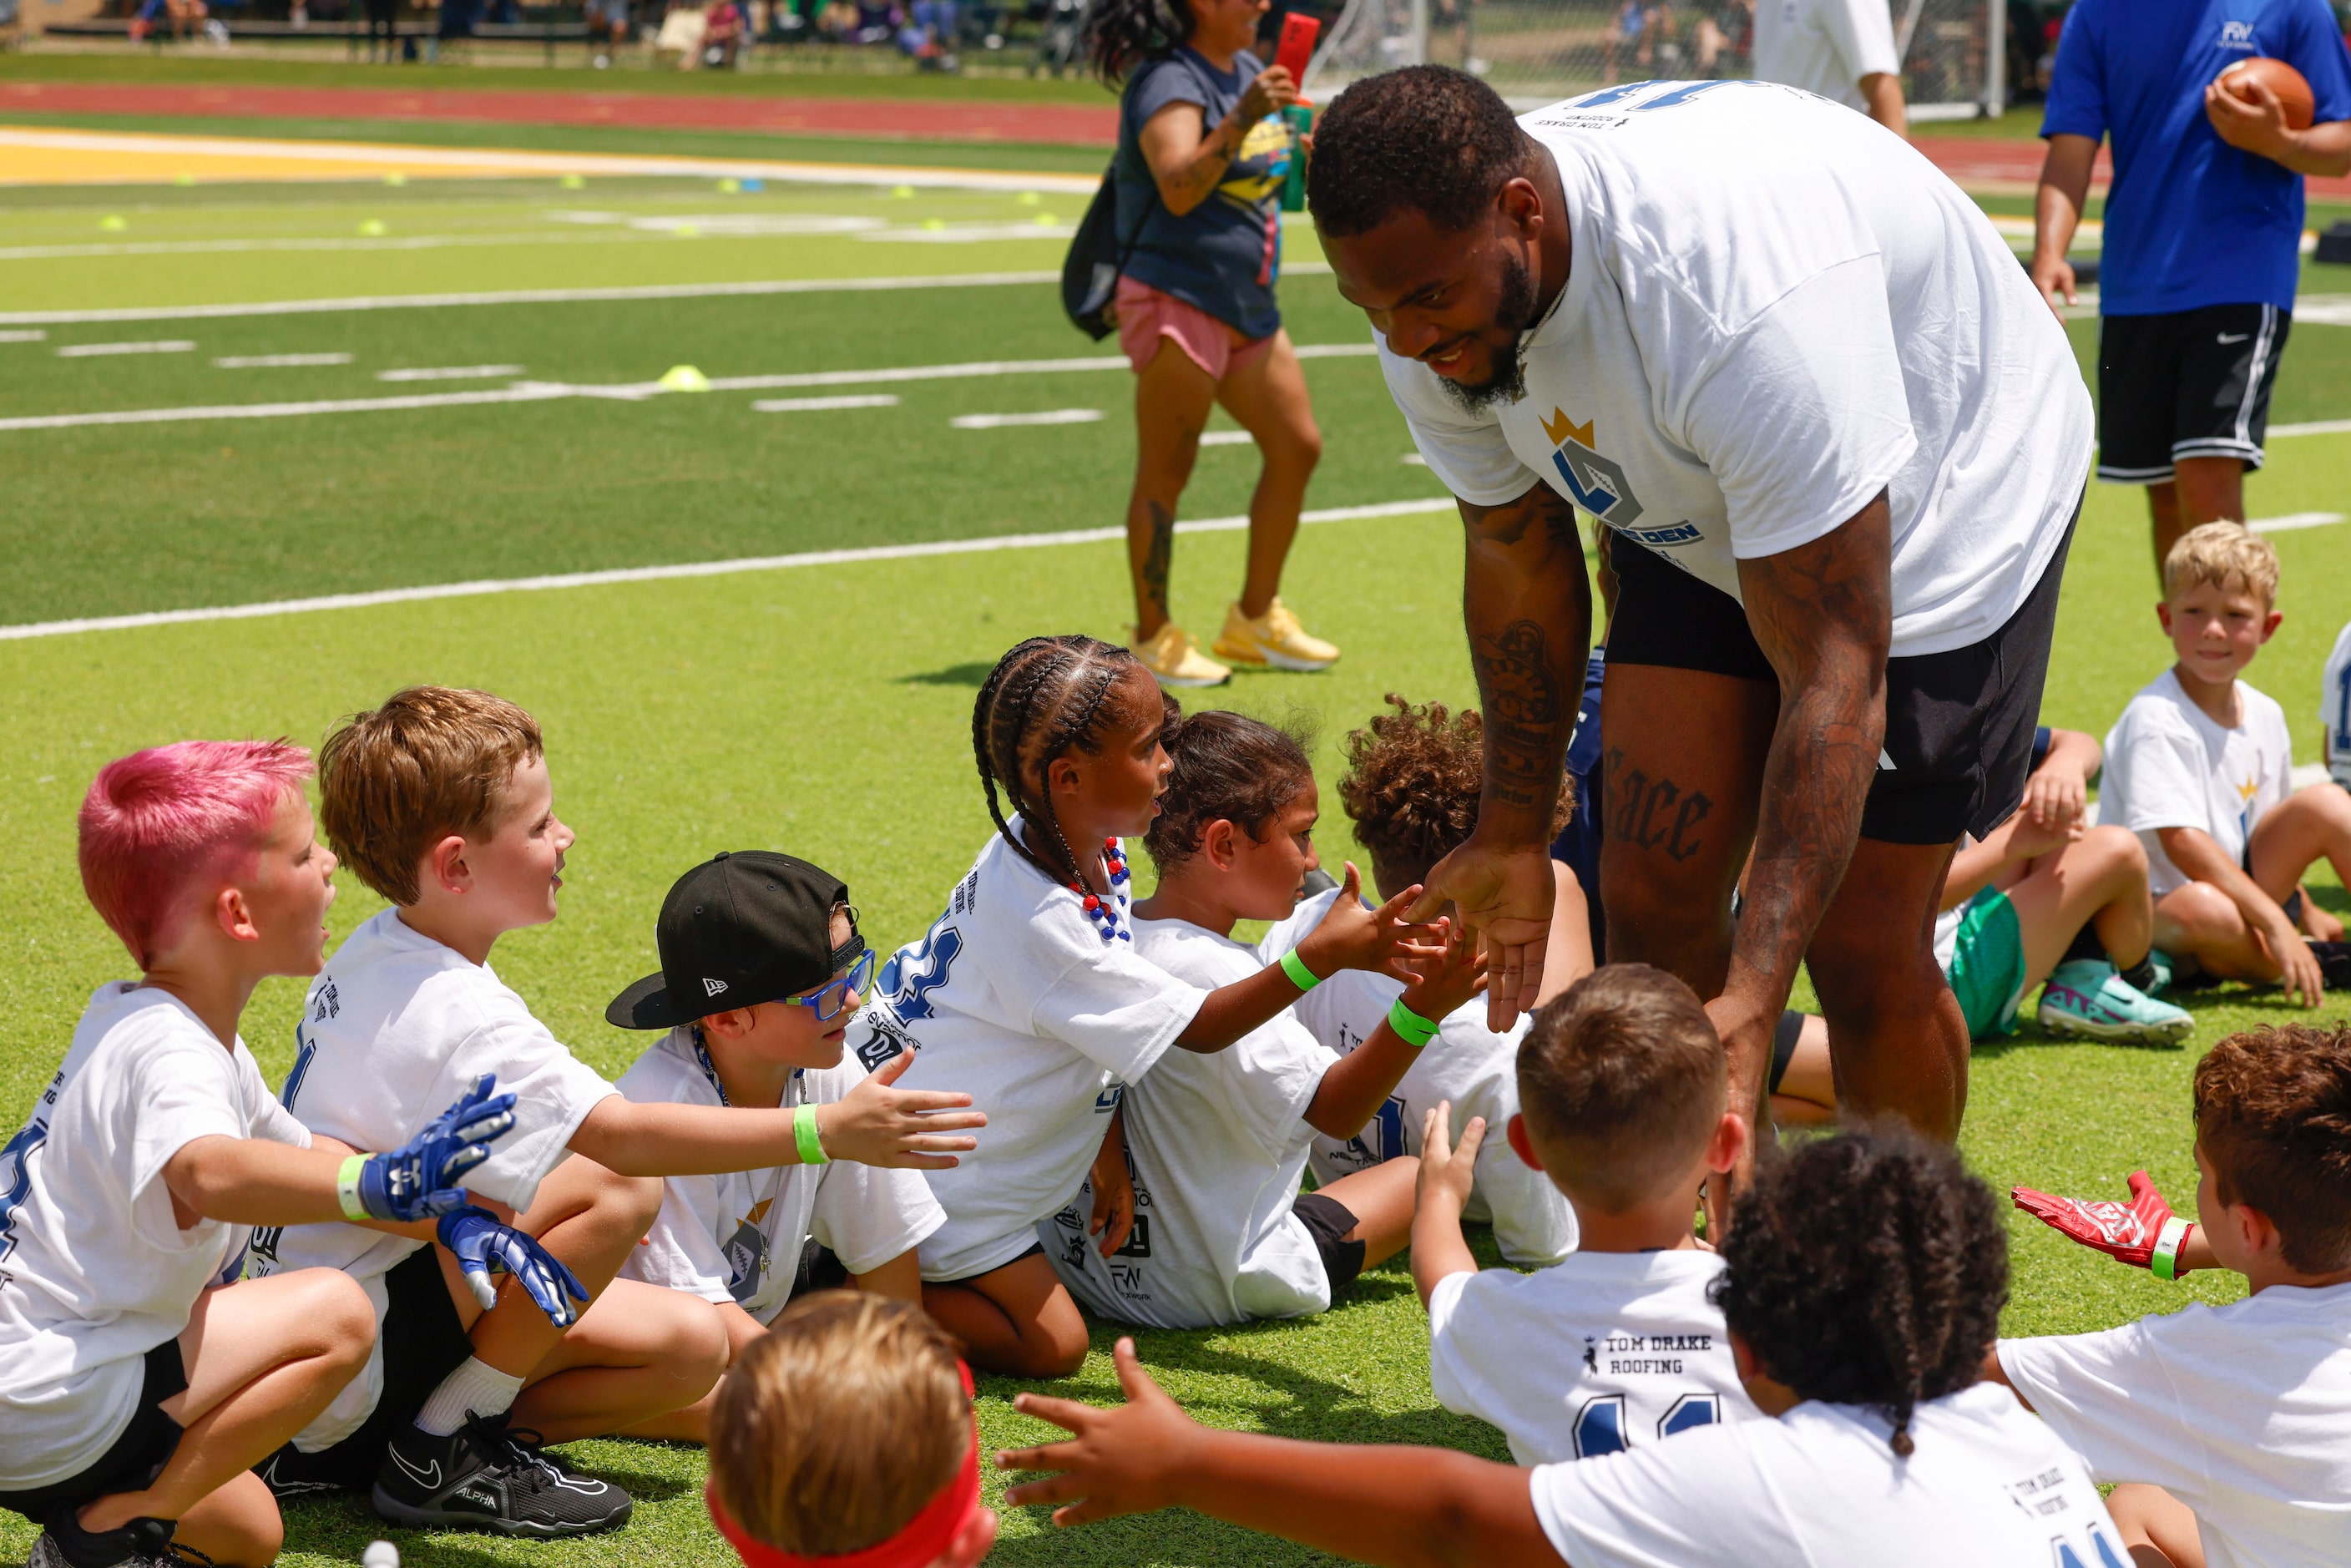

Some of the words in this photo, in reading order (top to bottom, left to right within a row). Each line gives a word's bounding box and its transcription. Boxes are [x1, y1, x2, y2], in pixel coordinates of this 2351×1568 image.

[1641, 524, 1701, 543] DEN
[1606, 1338, 1646, 1352] TOM
[1651, 1335, 1711, 1351] DRAKE
[1610, 1359, 1683, 1373] ROOFING
[456, 1487, 497, 1509] ALPHA
